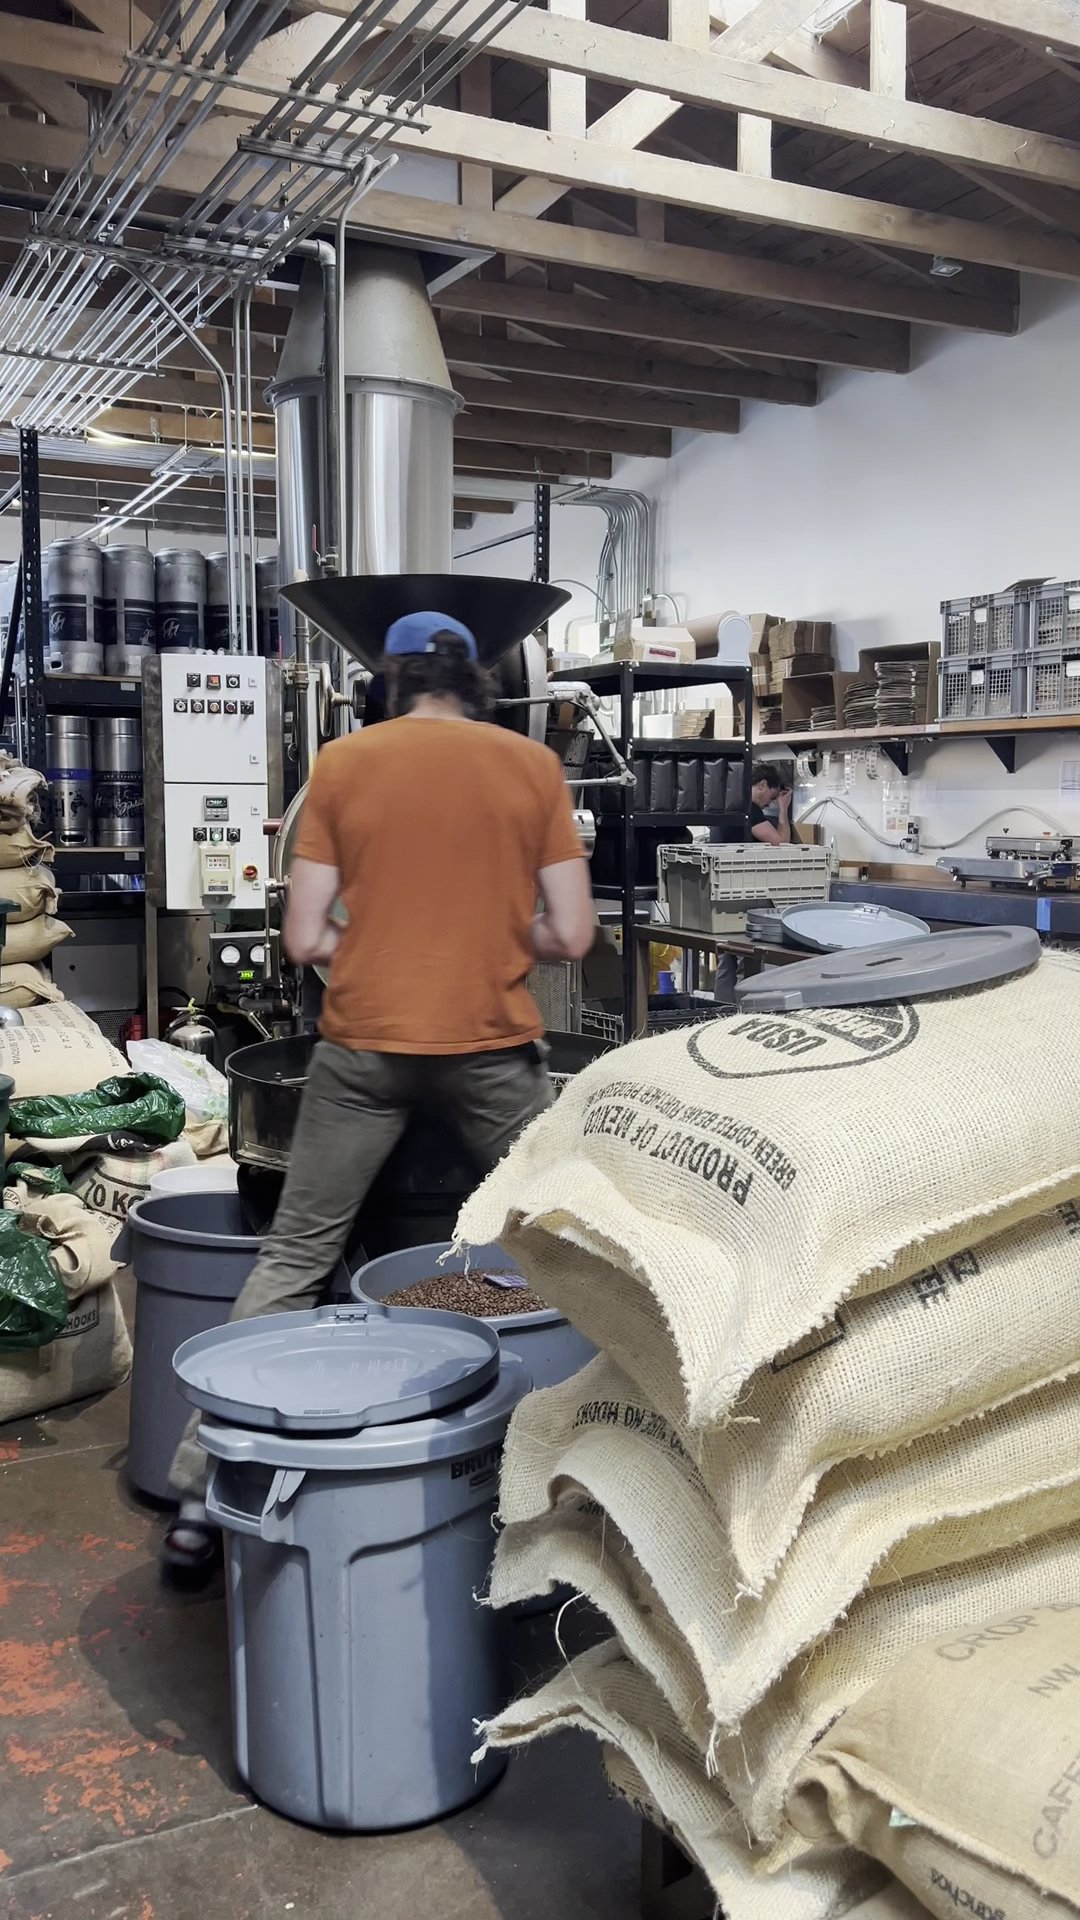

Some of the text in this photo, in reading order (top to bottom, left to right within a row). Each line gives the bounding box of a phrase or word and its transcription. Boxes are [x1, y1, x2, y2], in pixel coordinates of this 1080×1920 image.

[728, 1018, 827, 1056] USDA
[583, 1103, 638, 1140] MEXICO
[630, 1117, 659, 1151] OF
[678, 1106, 719, 1131] BEANS
[711, 1115, 759, 1148] COFFEE
[649, 1130, 754, 1207] PRODUCT
[751, 1136, 797, 1191] GREEN
[84, 1177, 107, 1208] 70
[572, 1400, 620, 1430] HOOKS
[451, 1445, 498, 1480] BRUT
[935, 1614, 1039, 1661] CROP
